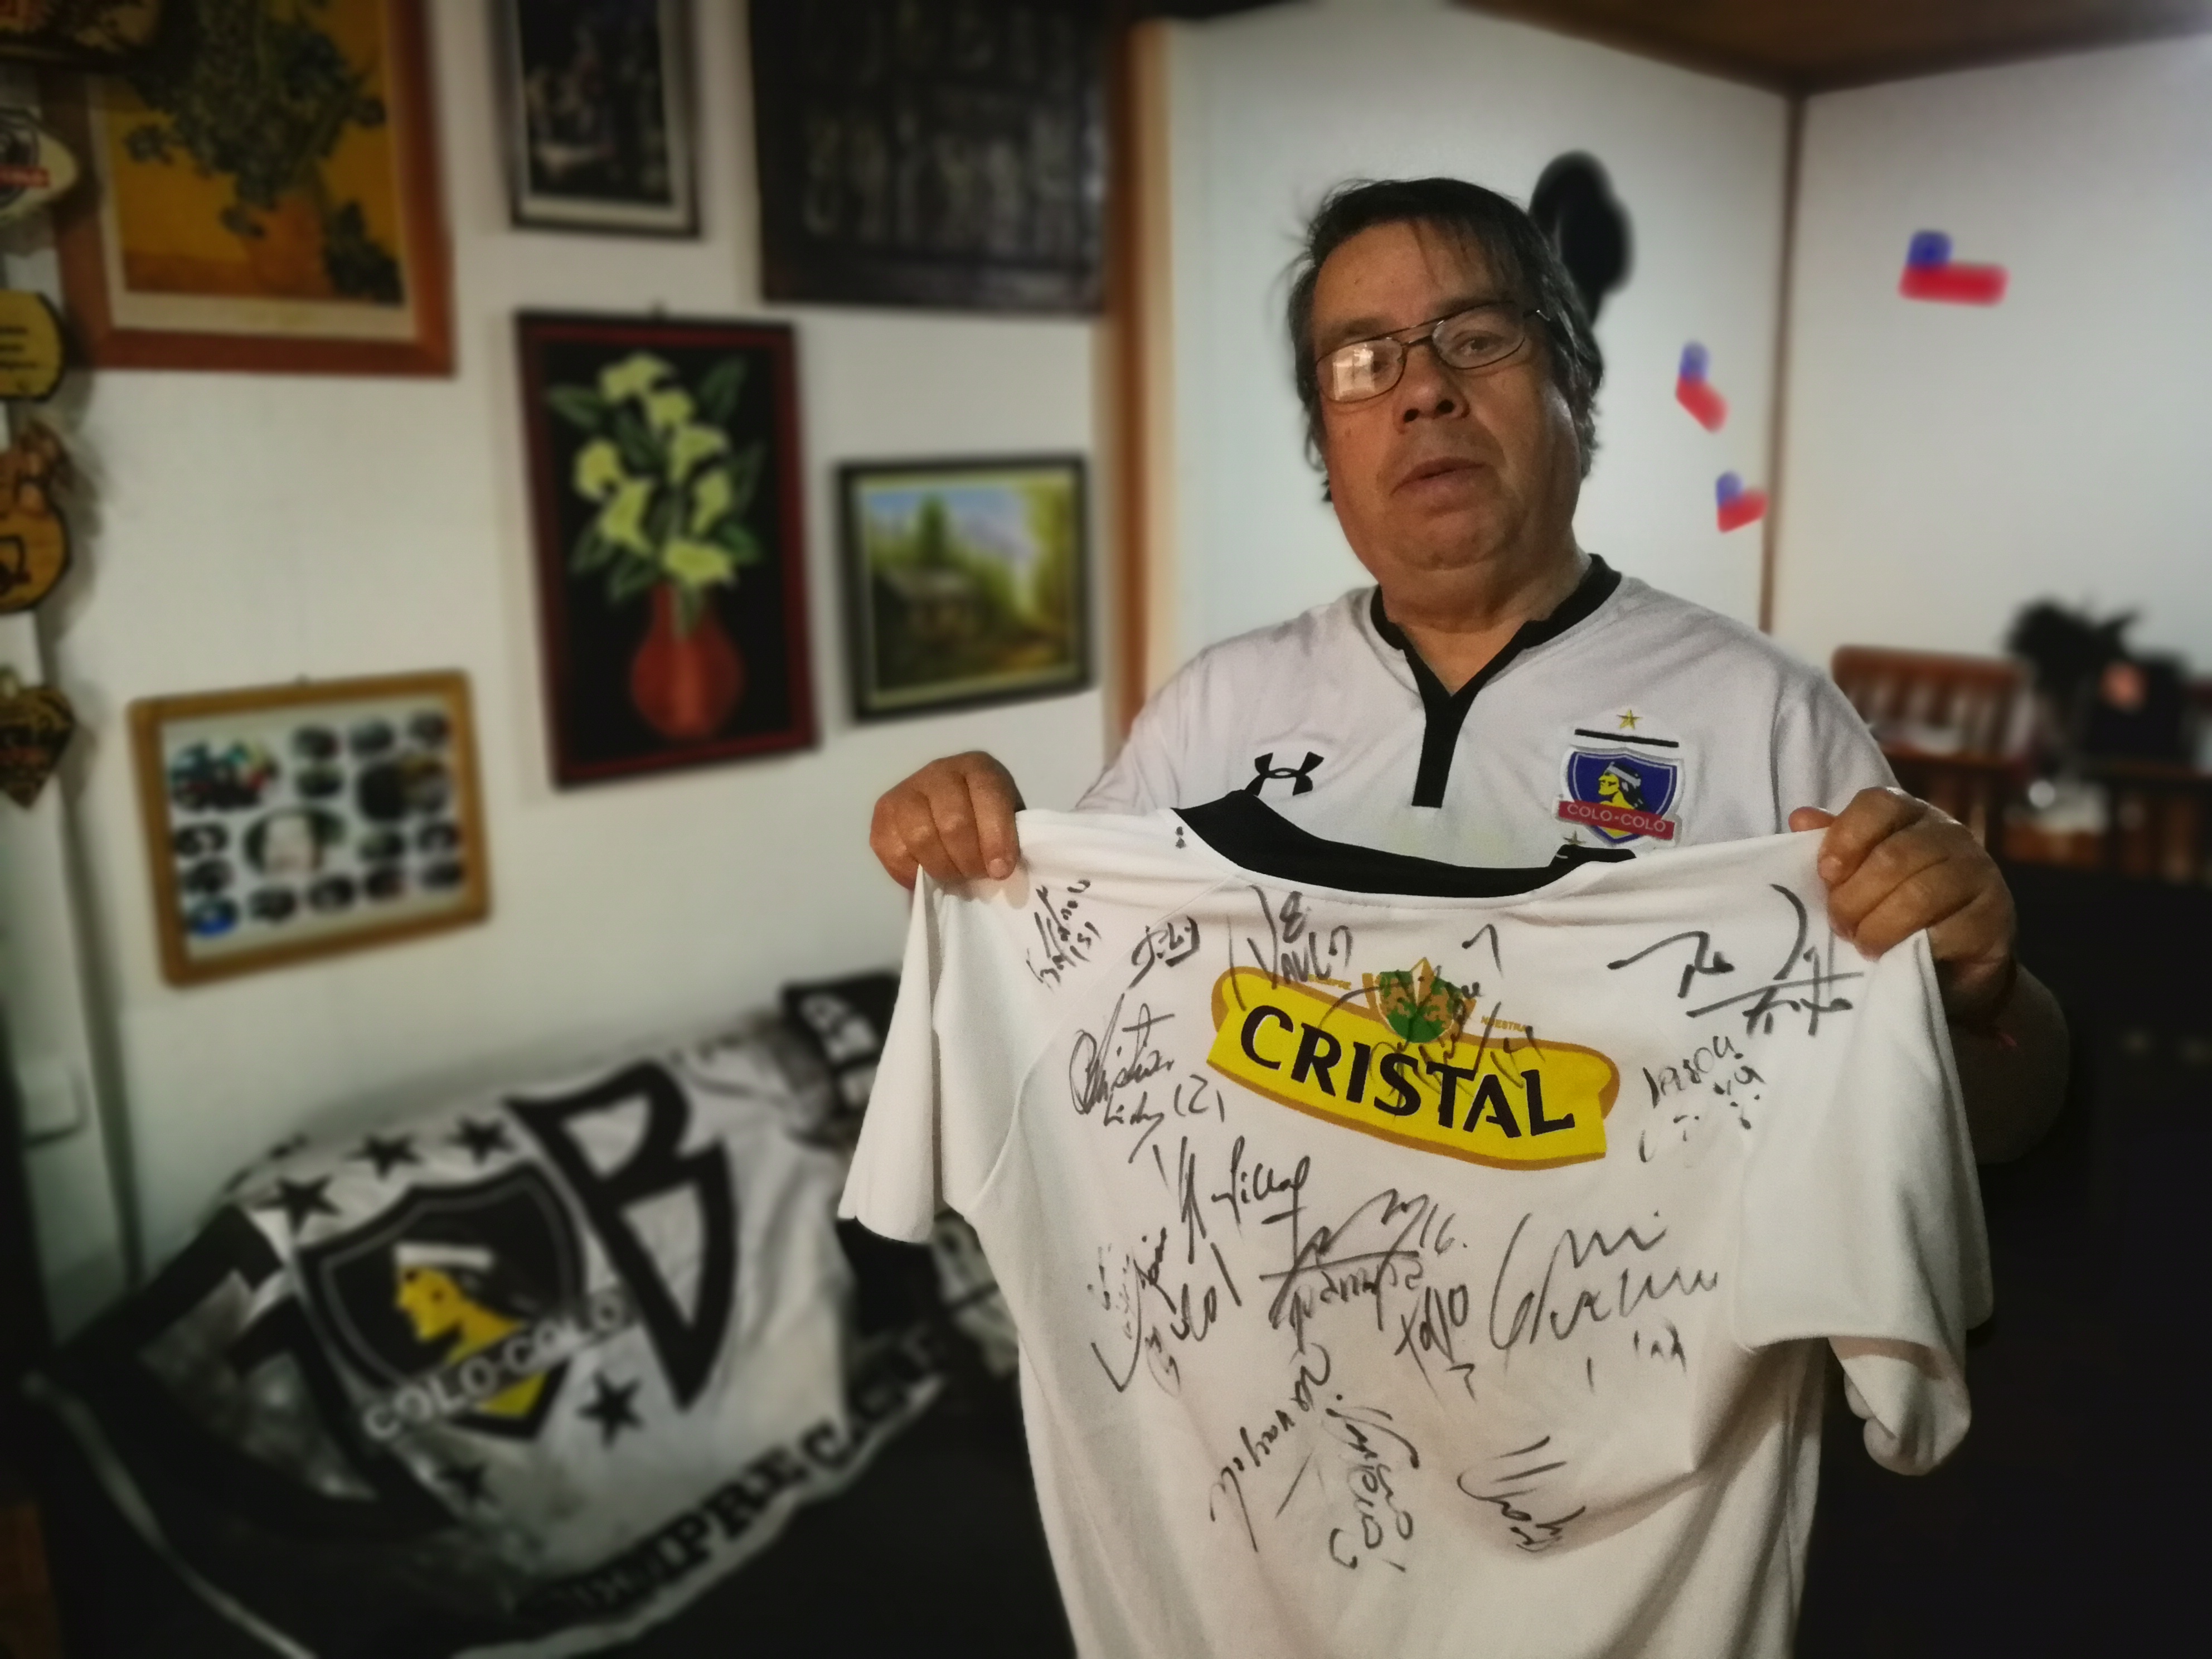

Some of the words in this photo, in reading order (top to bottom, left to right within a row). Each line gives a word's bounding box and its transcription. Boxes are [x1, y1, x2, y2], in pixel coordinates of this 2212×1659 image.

[1566, 803, 1667, 833] COLO-COLO
[1240, 1005, 1576, 1138] CRISTAL
[362, 1284, 629, 1444] COLO-COLO
